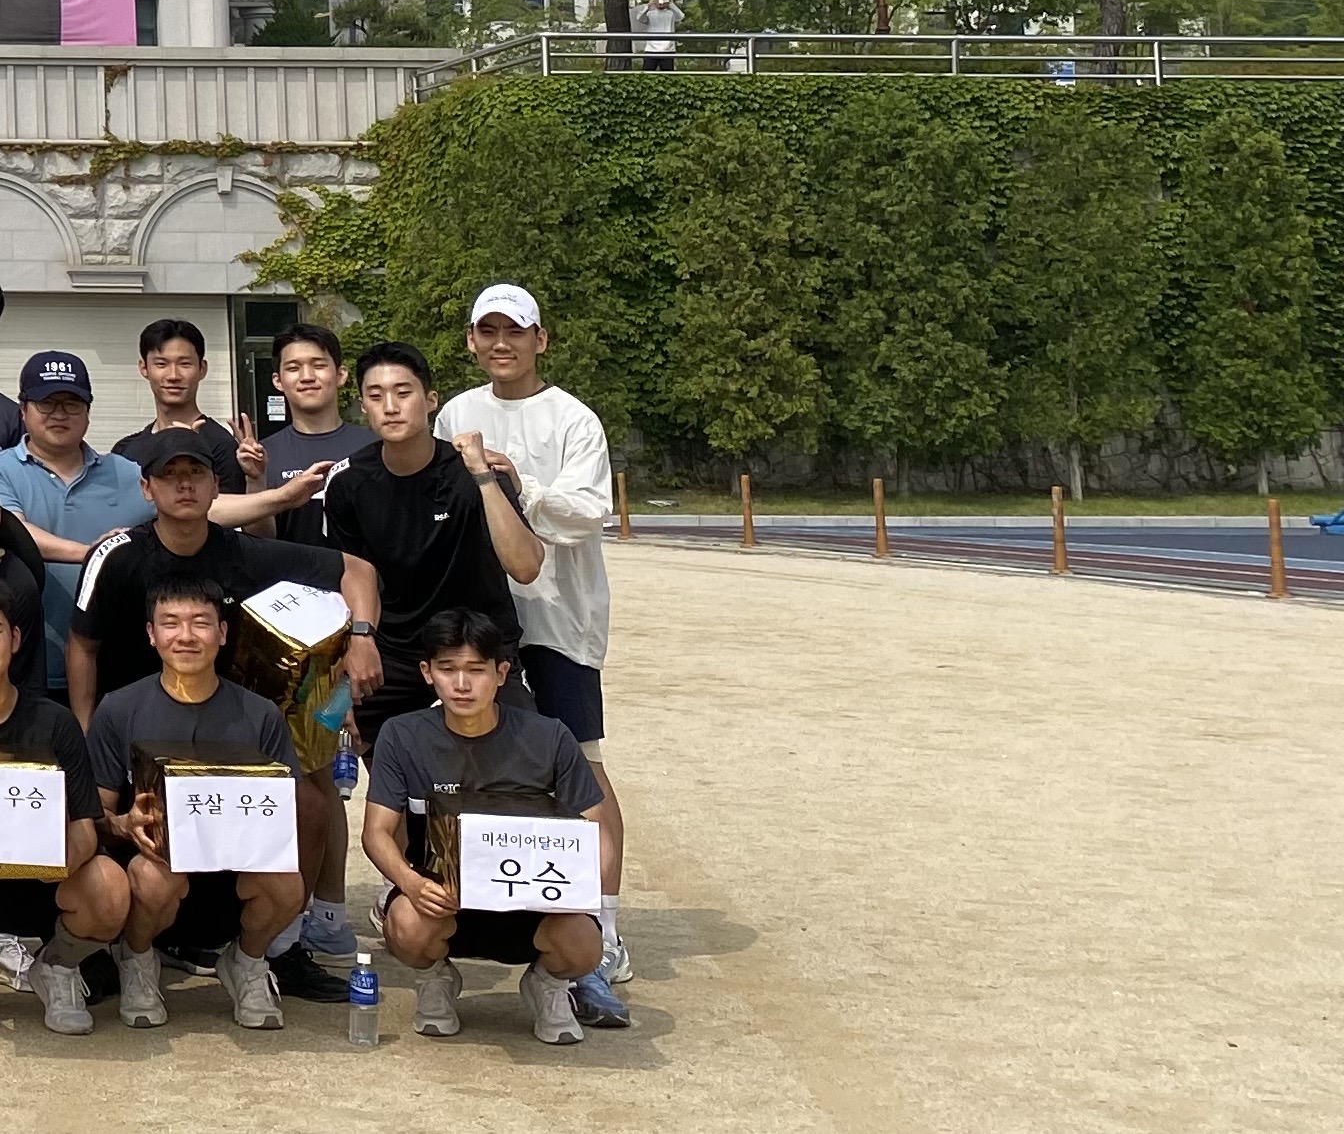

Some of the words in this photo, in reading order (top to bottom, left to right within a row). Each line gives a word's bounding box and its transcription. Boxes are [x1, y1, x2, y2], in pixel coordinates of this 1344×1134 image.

[44, 361, 72, 373] 1961
[269, 593, 301, 612] 피구
[4, 786, 47, 810] 우승
[185, 793, 225, 816] 풋살
[235, 794, 279, 817] 우승
[490, 858, 572, 901] 우승
